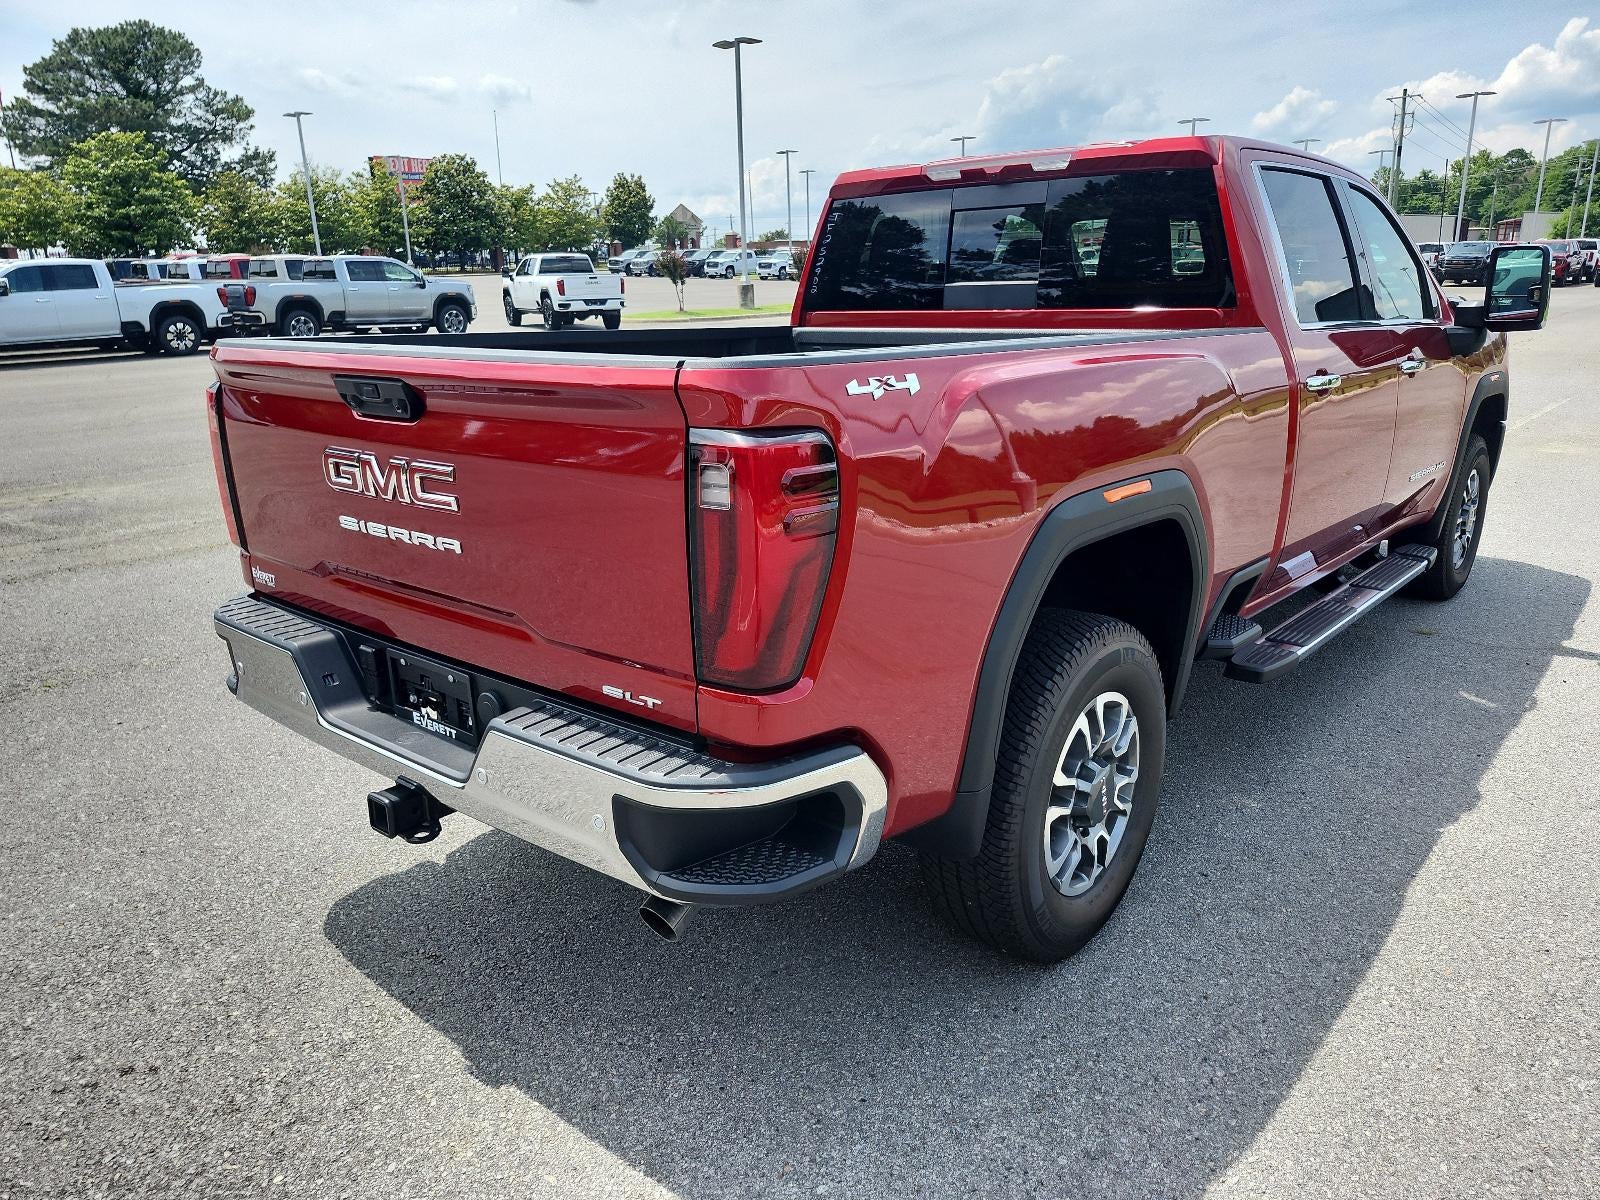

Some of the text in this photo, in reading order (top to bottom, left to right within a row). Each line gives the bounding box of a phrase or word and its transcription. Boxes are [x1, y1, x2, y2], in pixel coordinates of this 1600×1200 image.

[322, 445, 461, 515] GMC
[338, 515, 463, 554] SIERRA
[602, 685, 662, 709] SLT
[412, 711, 457, 739] EVERETT
